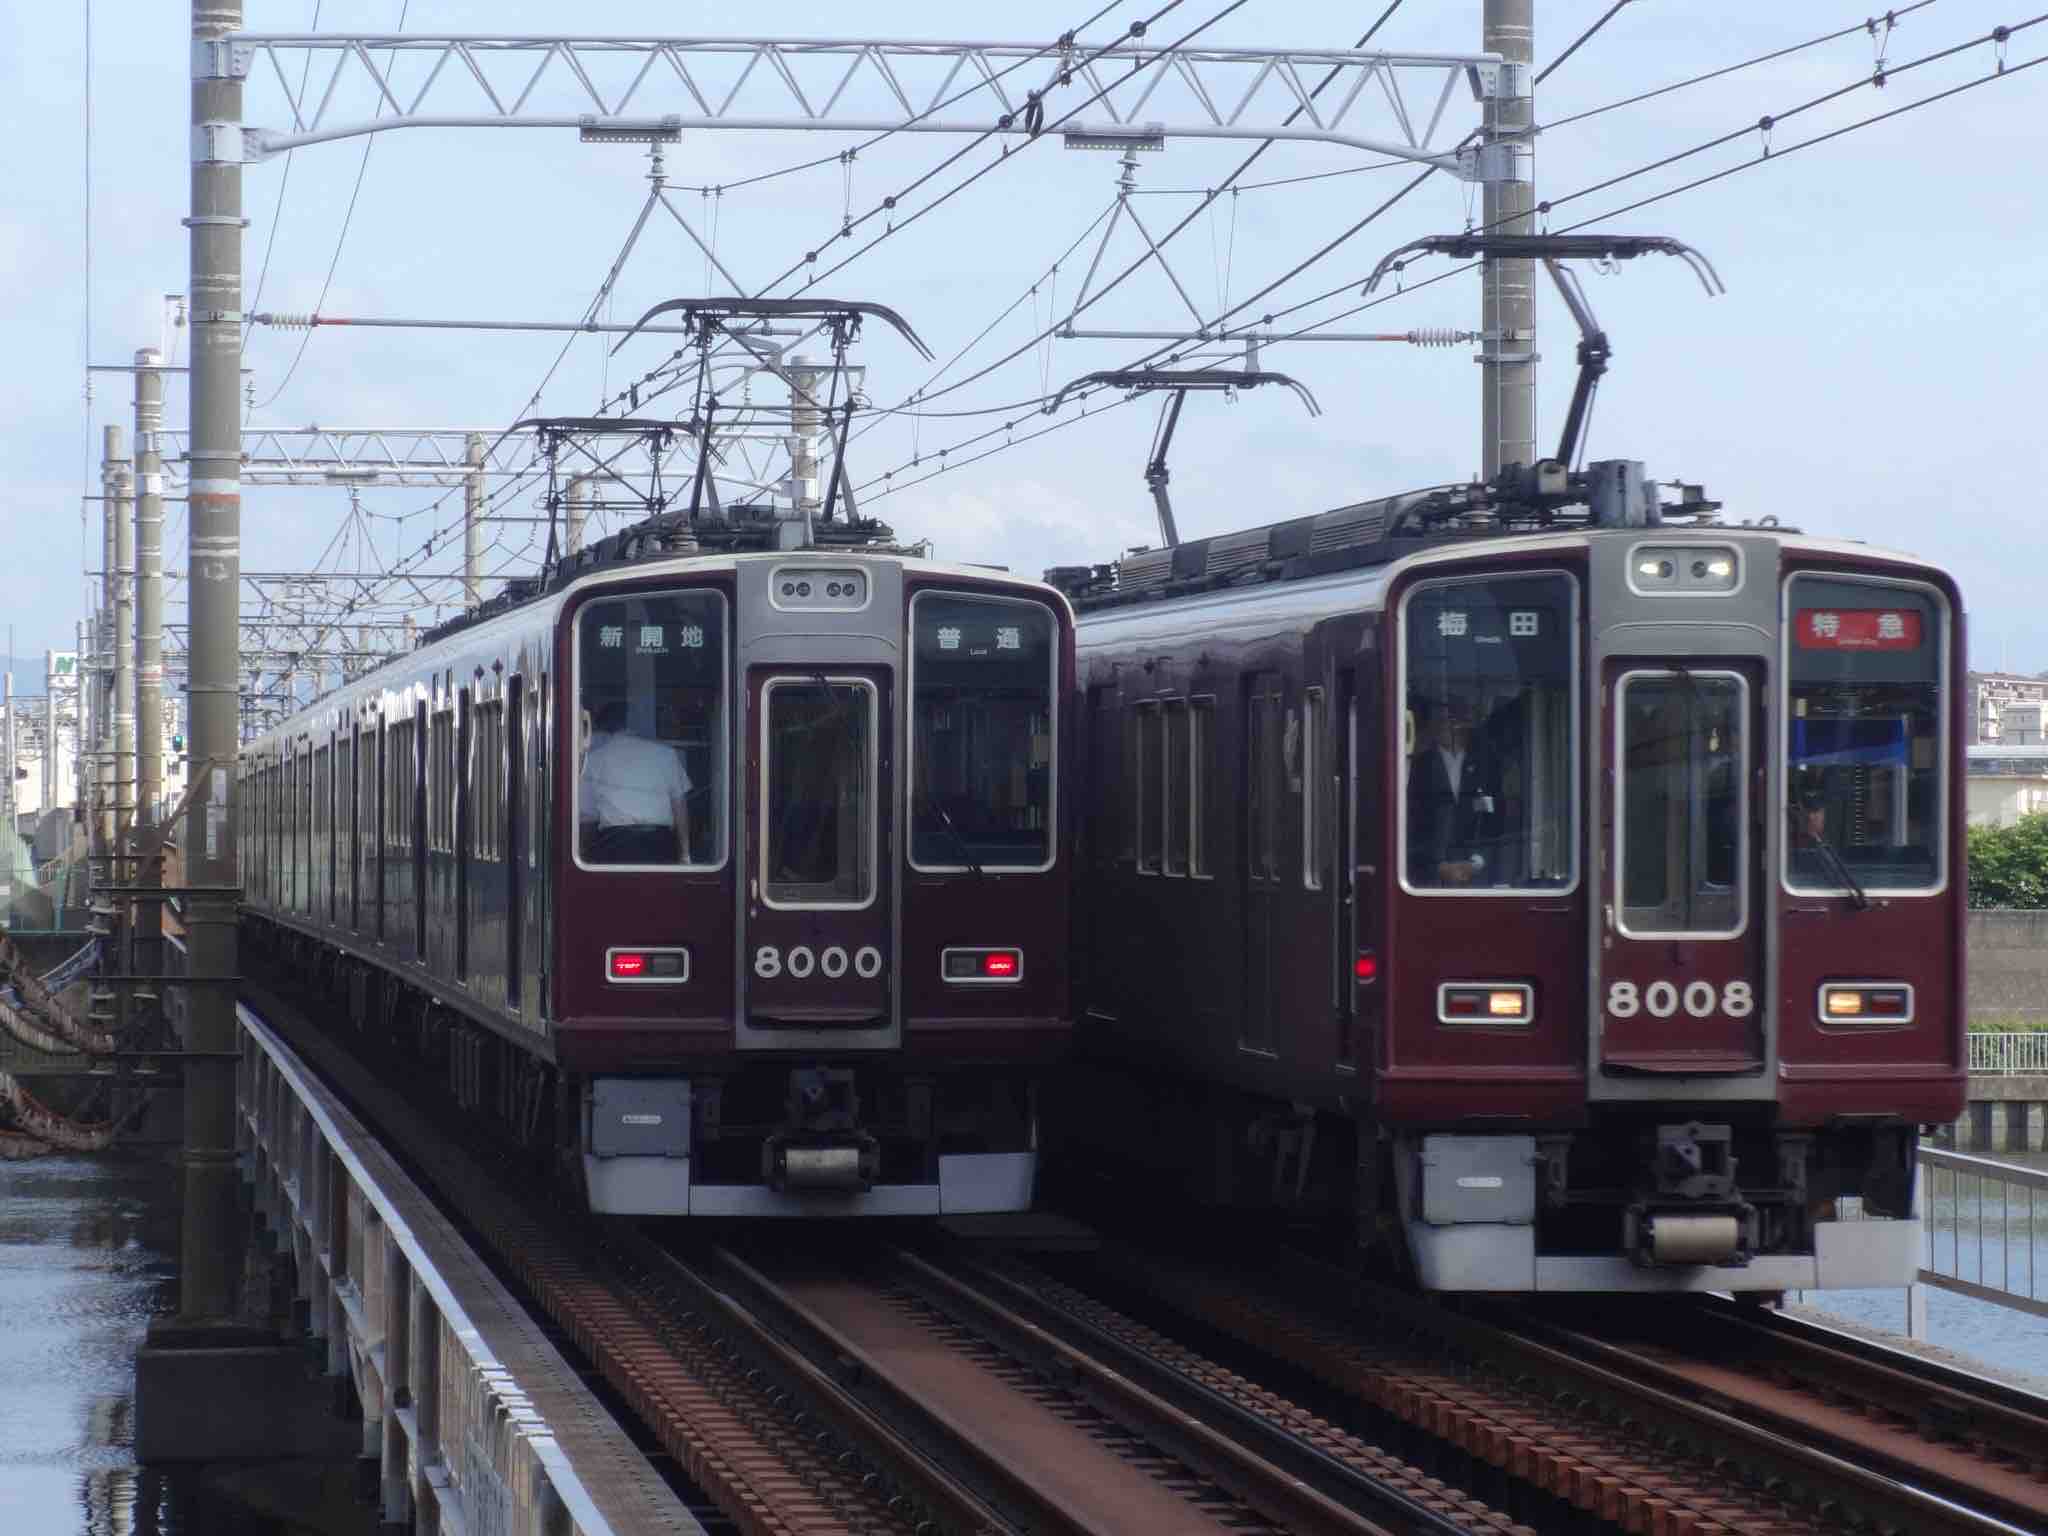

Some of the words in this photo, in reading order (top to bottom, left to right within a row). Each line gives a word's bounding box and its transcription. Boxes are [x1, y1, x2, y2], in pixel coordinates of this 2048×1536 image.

[599, 625, 704, 648] 新開地
[1437, 611, 1539, 636] 梅田
[1811, 612, 1905, 639] 特急
[937, 626, 1021, 649] 普通
[754, 946, 882, 978] 8000
[1607, 981, 1754, 1018] 8008
